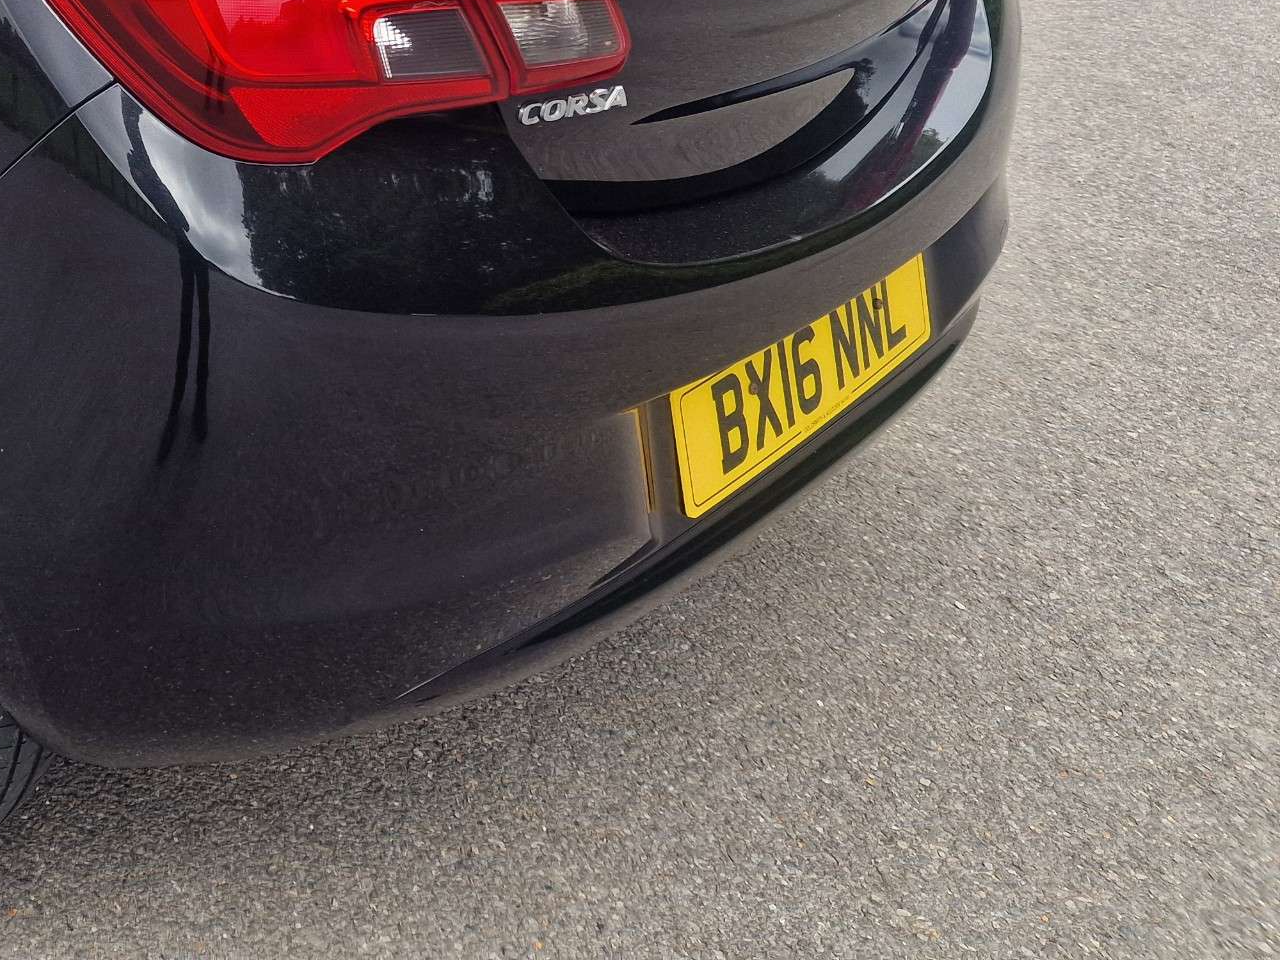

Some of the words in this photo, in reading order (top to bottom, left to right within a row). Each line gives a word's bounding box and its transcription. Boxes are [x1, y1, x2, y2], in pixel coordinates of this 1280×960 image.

[518, 85, 628, 126] CORSA
[711, 325, 823, 475] BX16
[828, 278, 907, 391] NNL
